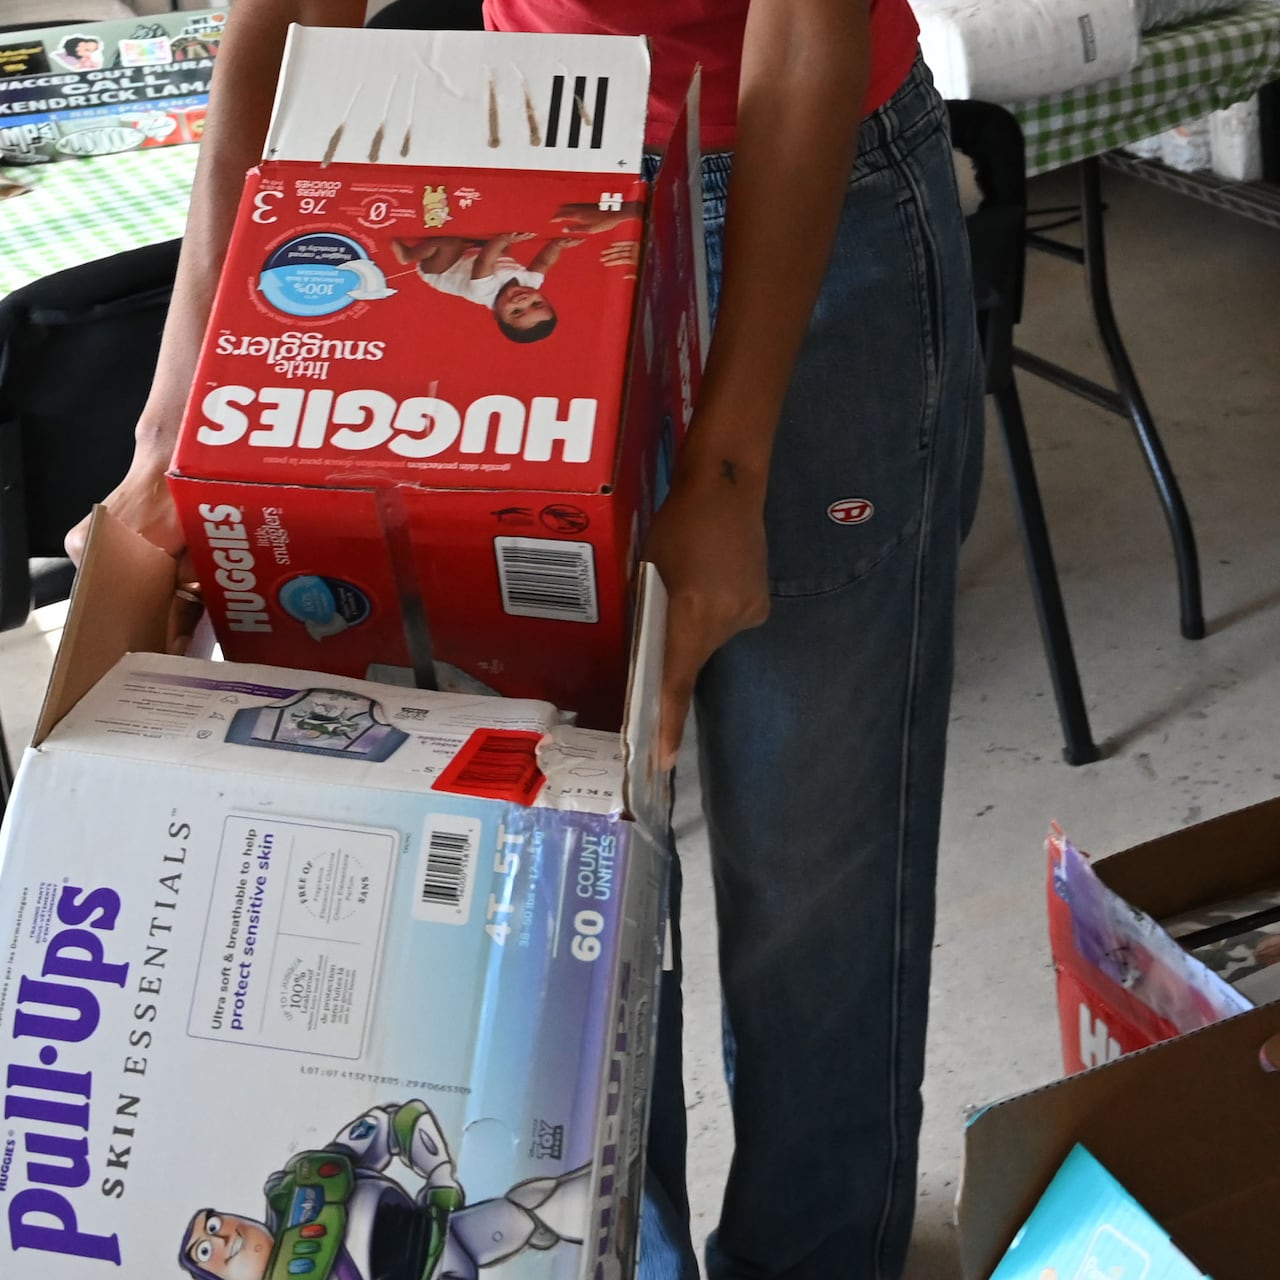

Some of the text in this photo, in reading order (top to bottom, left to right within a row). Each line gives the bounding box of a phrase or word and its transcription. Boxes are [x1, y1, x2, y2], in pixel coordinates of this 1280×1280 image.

[61, 74, 171, 95] CALL
[86, 68, 137, 82] OUT
[251, 190, 327, 224] 3 76
[293, 282, 333, 296] 100%
[215, 331, 387, 364] snugglers
[274, 358, 330, 380] little
[196, 384, 598, 463] HUGGIES
[261, 506, 291, 566] snugglers
[198, 503, 273, 632] HUGGIES
[297, 860, 315, 905] FREE OF
[358, 876, 370, 904] SANS
[571, 831, 605, 961] 60 COUNT
[211, 828, 258, 1030] Ultra soft & breathable to help
[230, 832, 274, 1031] protect sensitive skin
[101, 820, 192, 1199] SKIN ESSENTIALS
[290, 971, 307, 1009] 100%
[1079, 1001, 1122, 1068] H
